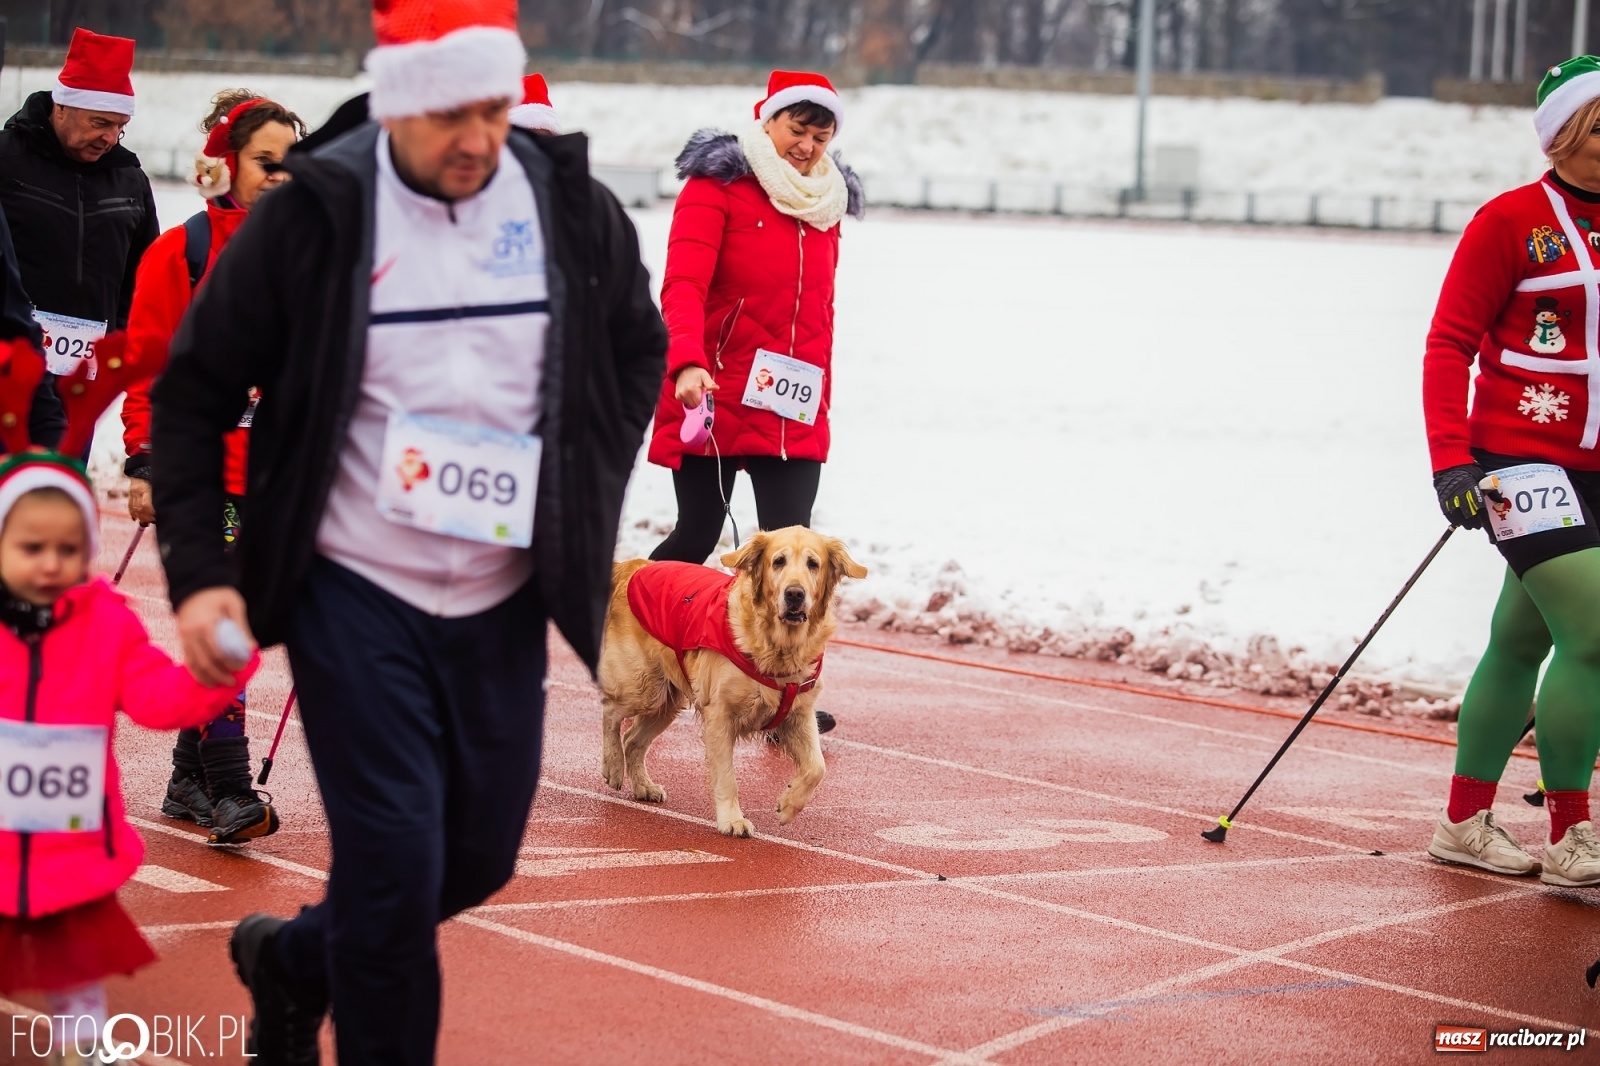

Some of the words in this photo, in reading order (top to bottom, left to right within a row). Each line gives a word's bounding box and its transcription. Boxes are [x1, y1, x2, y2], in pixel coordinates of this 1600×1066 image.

[55, 336, 95, 359] 025
[775, 378, 812, 403] 019
[438, 462, 517, 506] 069
[1515, 486, 1570, 513] 072
[7, 764, 90, 799] 068
